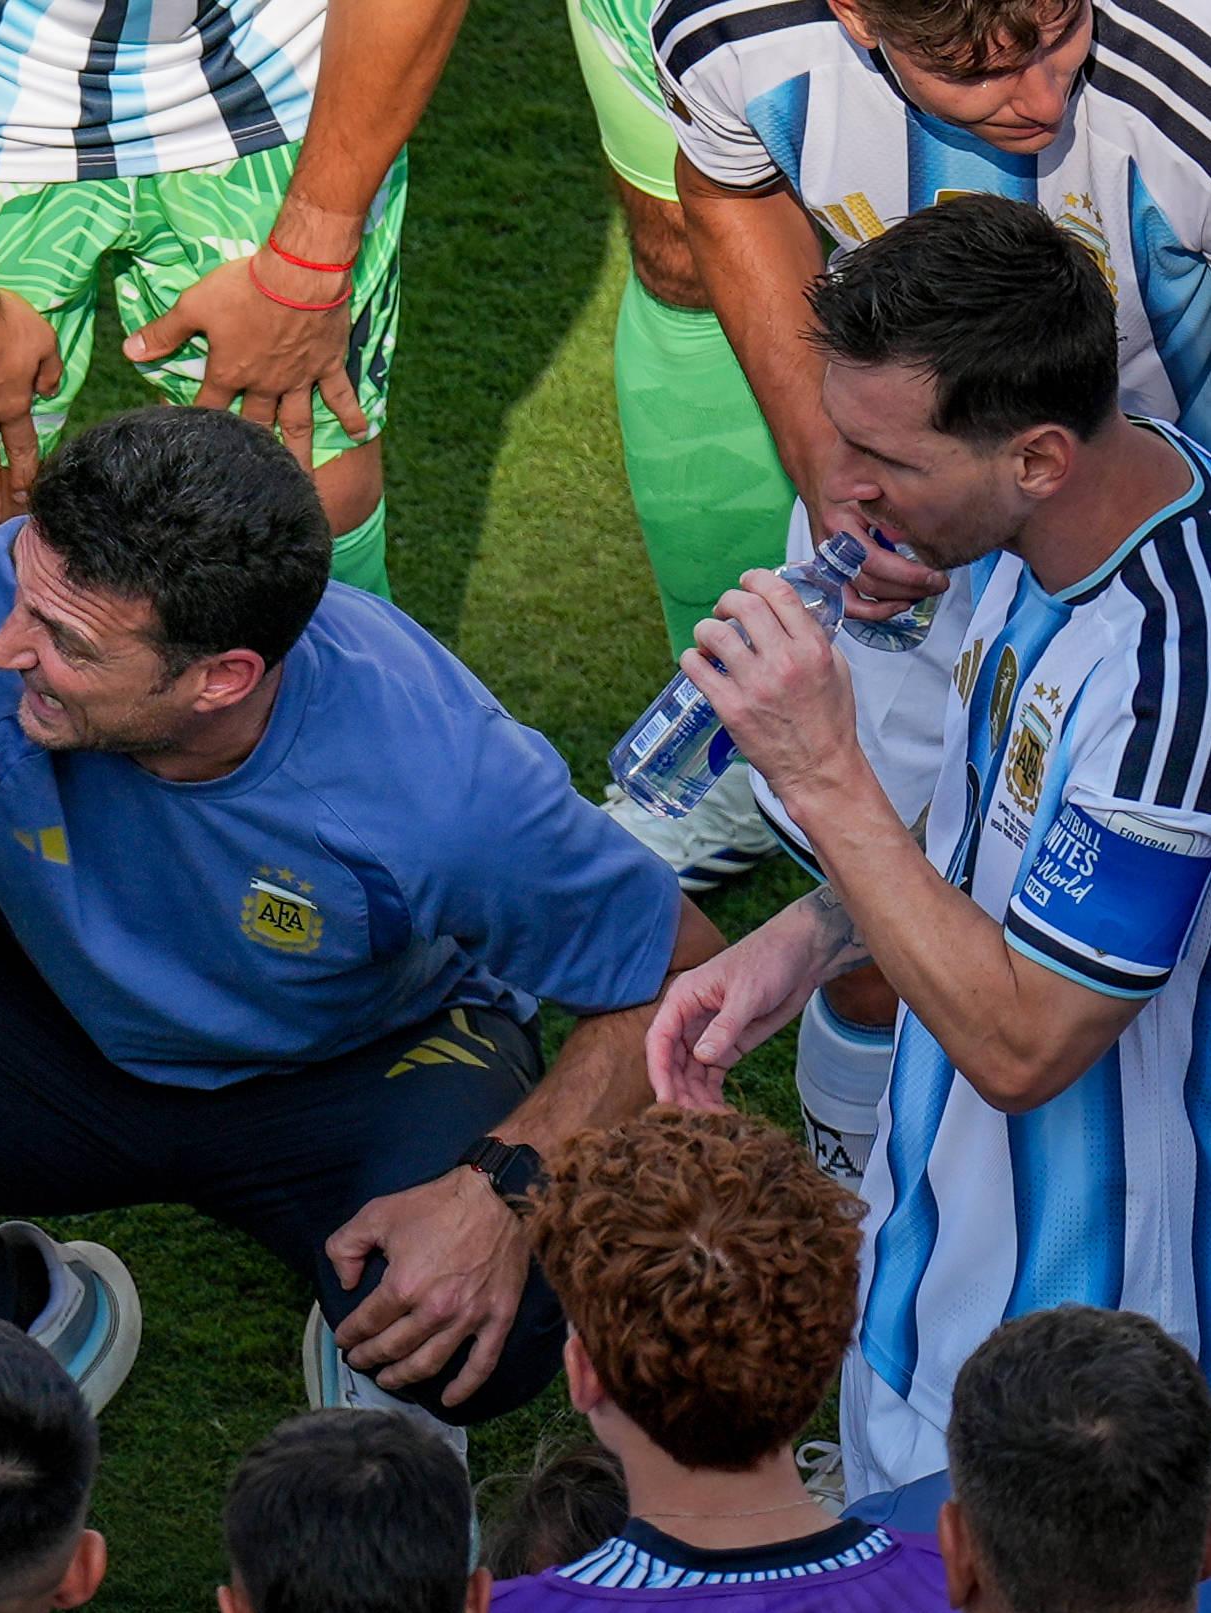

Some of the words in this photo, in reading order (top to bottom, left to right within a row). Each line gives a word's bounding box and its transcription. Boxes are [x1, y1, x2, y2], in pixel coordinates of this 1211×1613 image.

[1026, 877, 1045, 903] FIFA
[1036, 853, 1094, 905] World
[257, 894, 306, 933] AFA
[802, 1103, 866, 1178] FA
